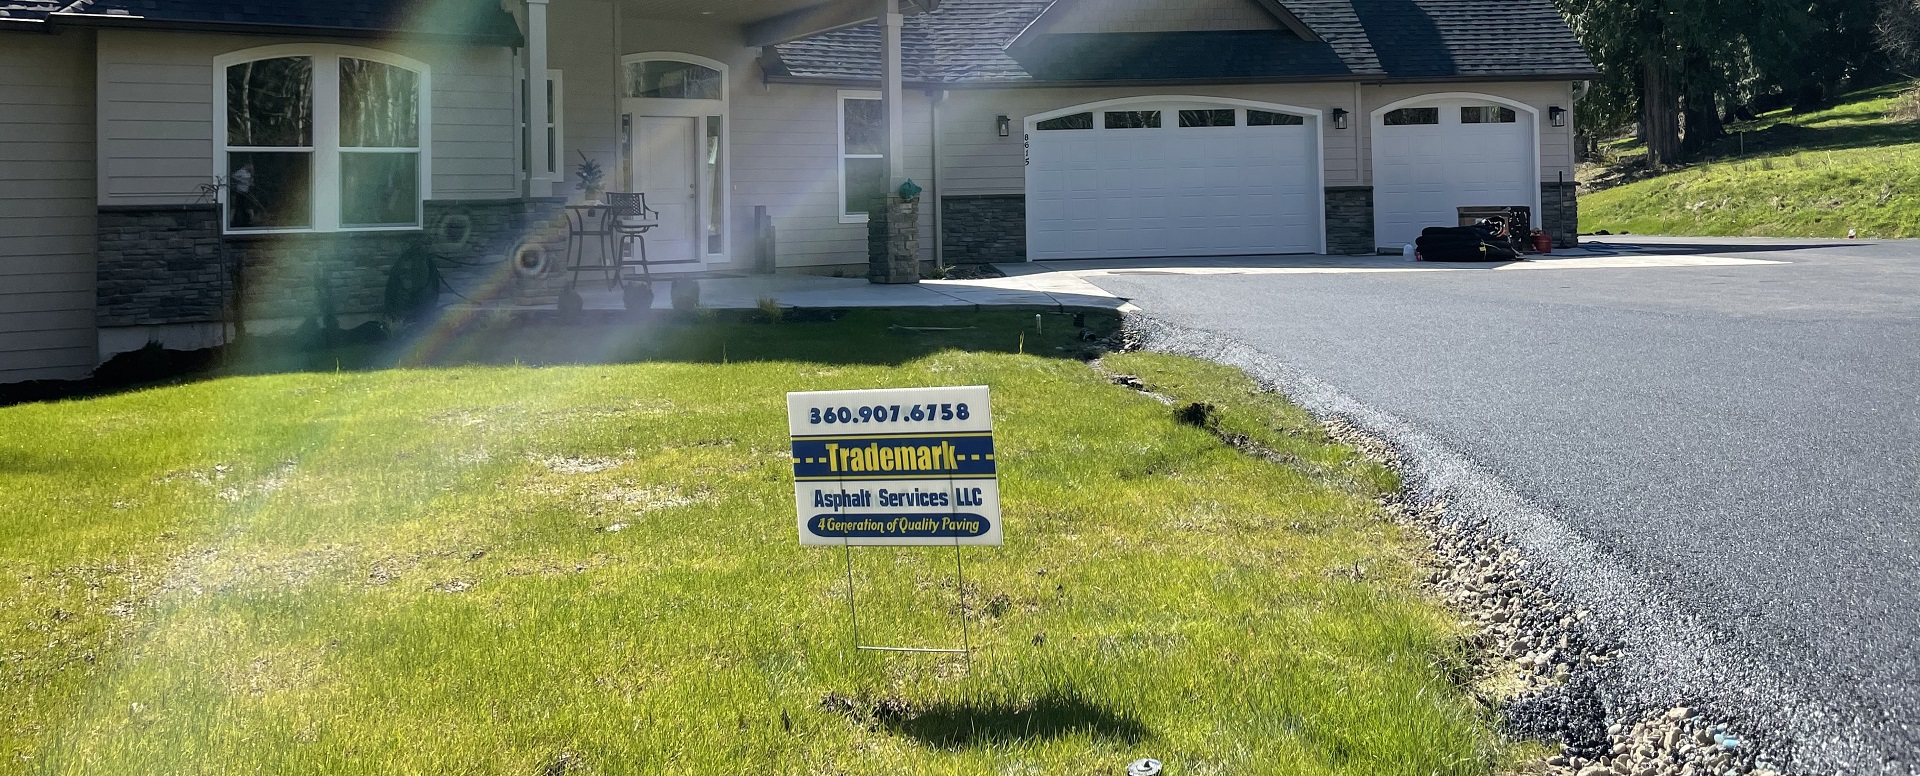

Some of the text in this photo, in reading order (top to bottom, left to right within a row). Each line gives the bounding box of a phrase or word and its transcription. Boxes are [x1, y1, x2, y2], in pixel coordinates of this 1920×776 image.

[810, 403, 970, 424] 360.907.6758
[825, 440, 958, 472] Trademark
[814, 487, 983, 512] Asphalt Services LLC
[817, 517, 980, 534] 4 Generation of Quality Paving
